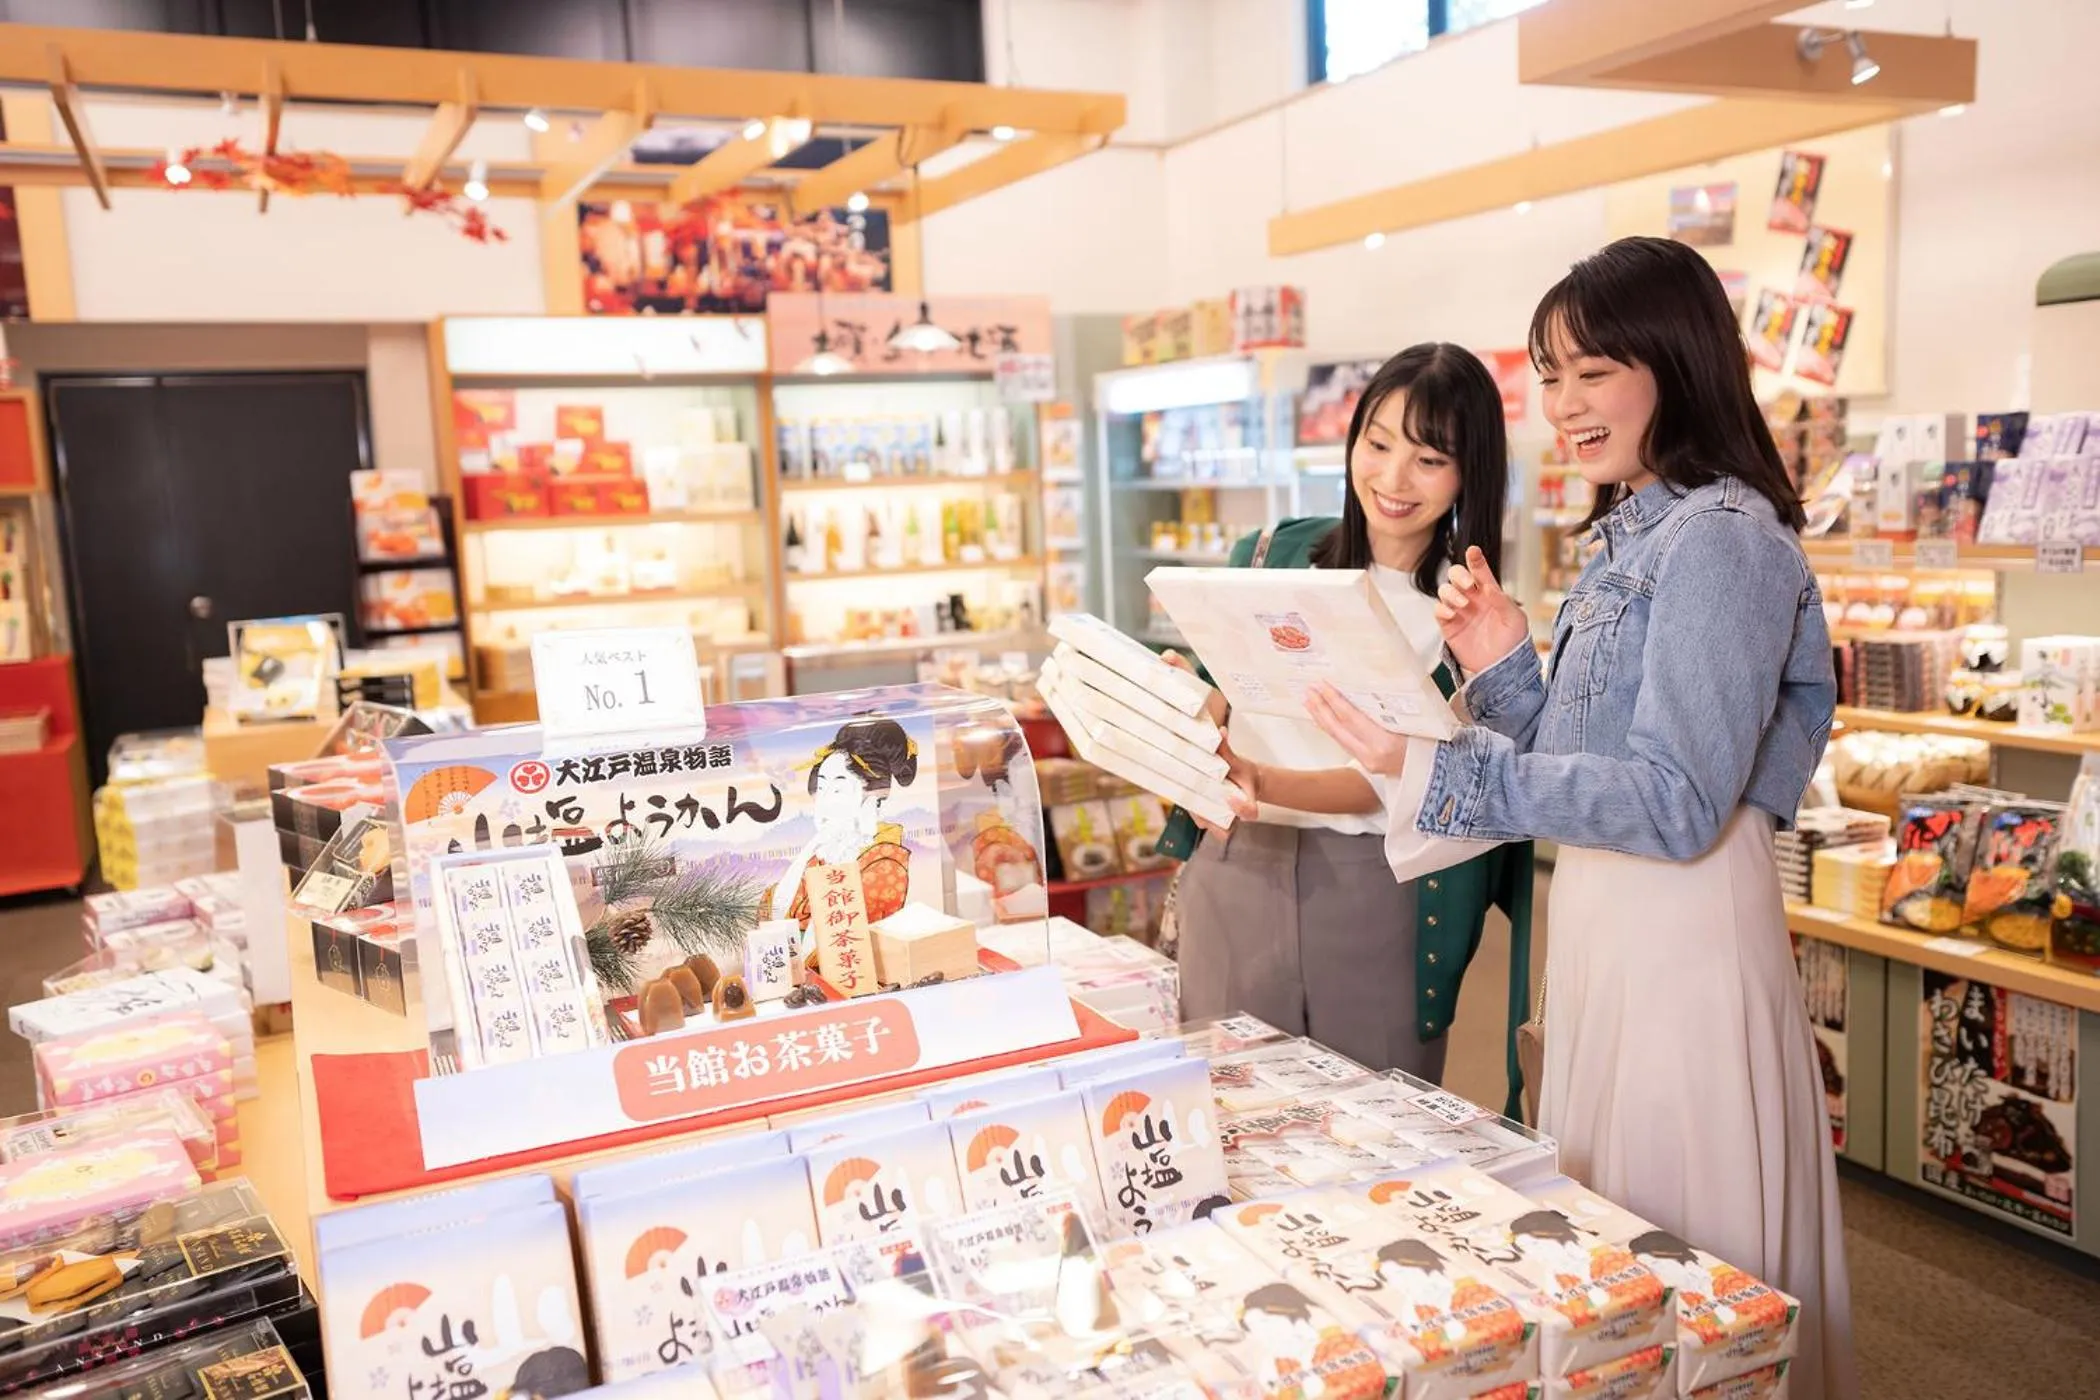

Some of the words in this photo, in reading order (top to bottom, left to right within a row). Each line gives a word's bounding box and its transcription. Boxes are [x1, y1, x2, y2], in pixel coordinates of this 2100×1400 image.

[584, 684, 622, 710] No.
[634, 669, 655, 704] 1
[556, 745, 733, 786] 大江戸温泉物語
[822, 869, 864, 989] 当館御茶菓子
[644, 1016, 890, 1096] 当館お茶菓子
[1929, 988, 1961, 1158] わさび昆布
[1960, 985, 1989, 1126] まいたけ
[1132, 1114, 1183, 1189] 山塩
[1277, 1213, 1350, 1248] 山塩
[1408, 1190, 1482, 1223] 山塩
[1279, 1237, 1383, 1294] ようかん
[1413, 1214, 1522, 1266] ようかん
